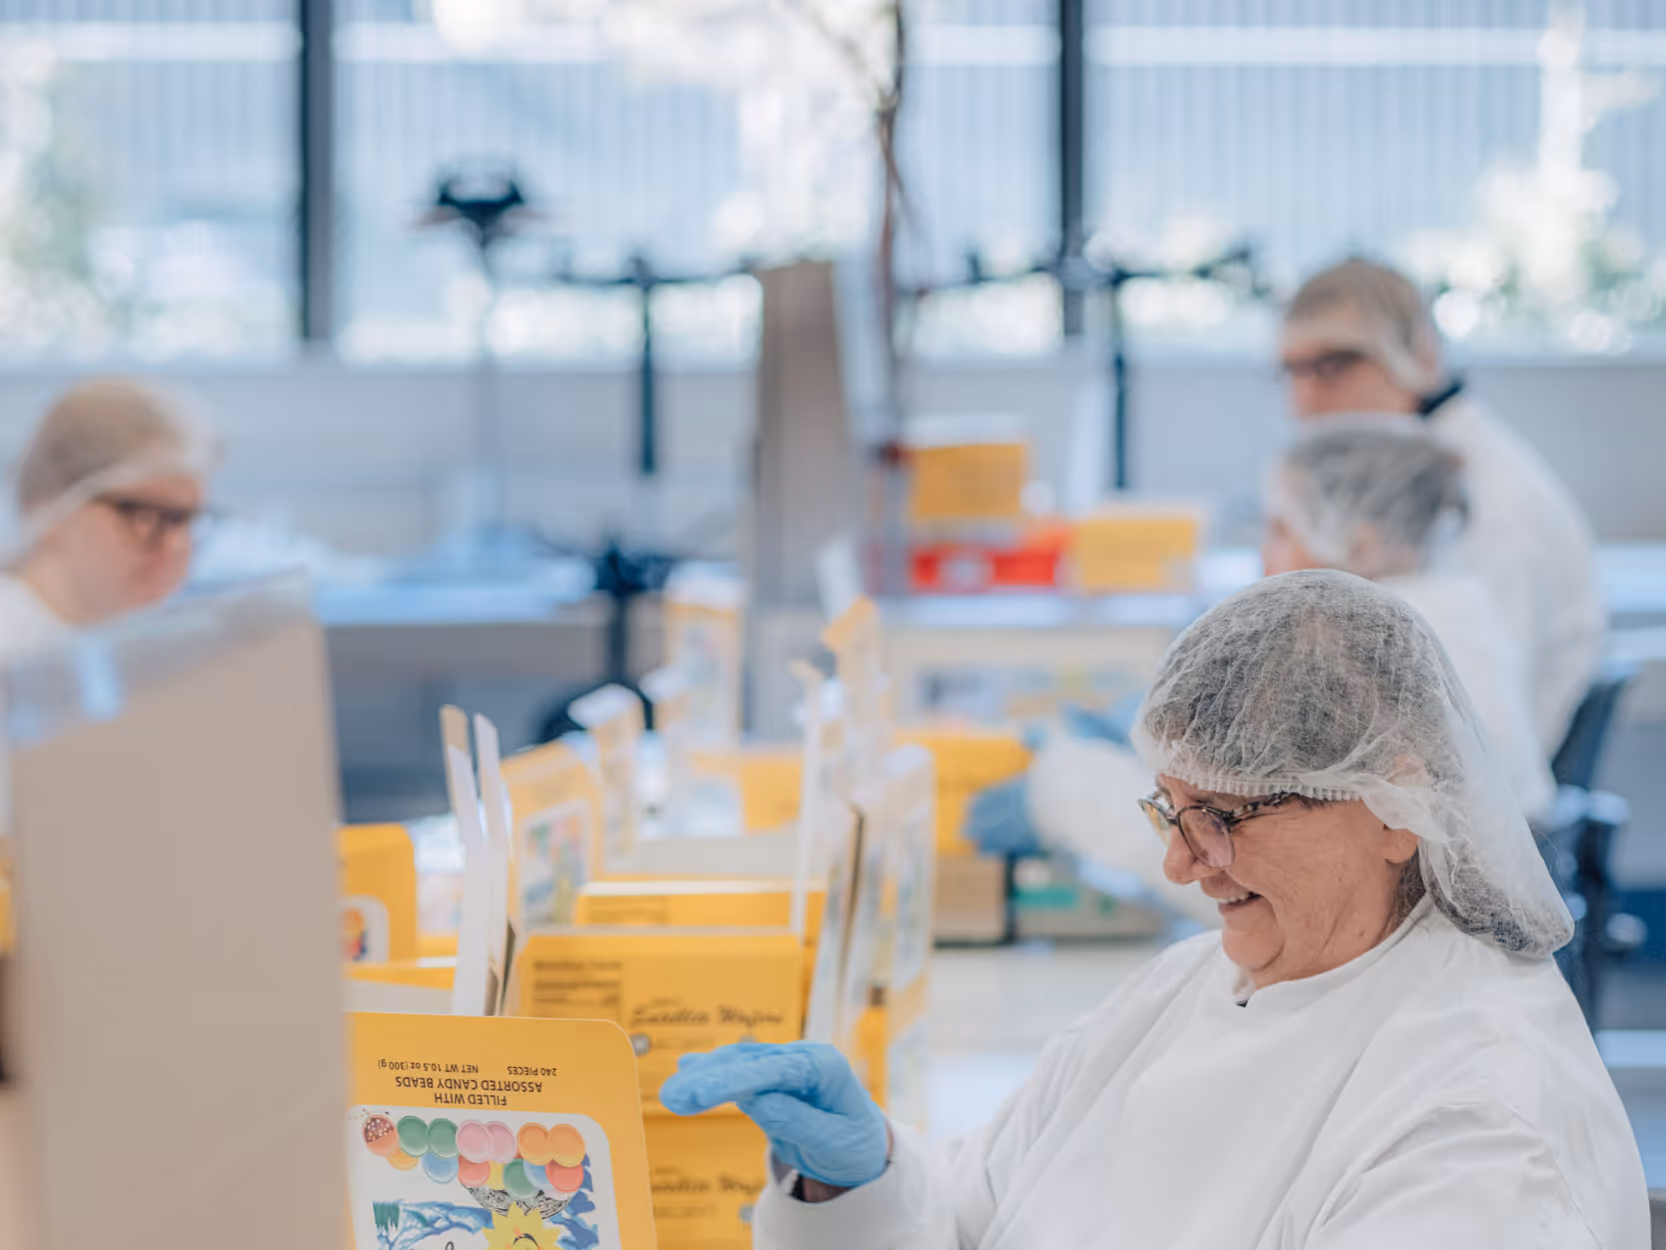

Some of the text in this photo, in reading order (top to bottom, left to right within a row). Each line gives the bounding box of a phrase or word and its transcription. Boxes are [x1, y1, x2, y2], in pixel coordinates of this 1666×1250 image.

[410, 1062, 422, 1070] oz
[423, 1062, 442, 1072] 10.5
[445, 1063, 460, 1073] WT
[461, 1064, 479, 1074] NET
[507, 1065, 538, 1076] PIECES
[540, 1067, 557, 1077] 240
[395, 1076, 543, 1093] ASSORTED CANDY BEADS
[434, 1092, 508, 1106] FILLED WITH
